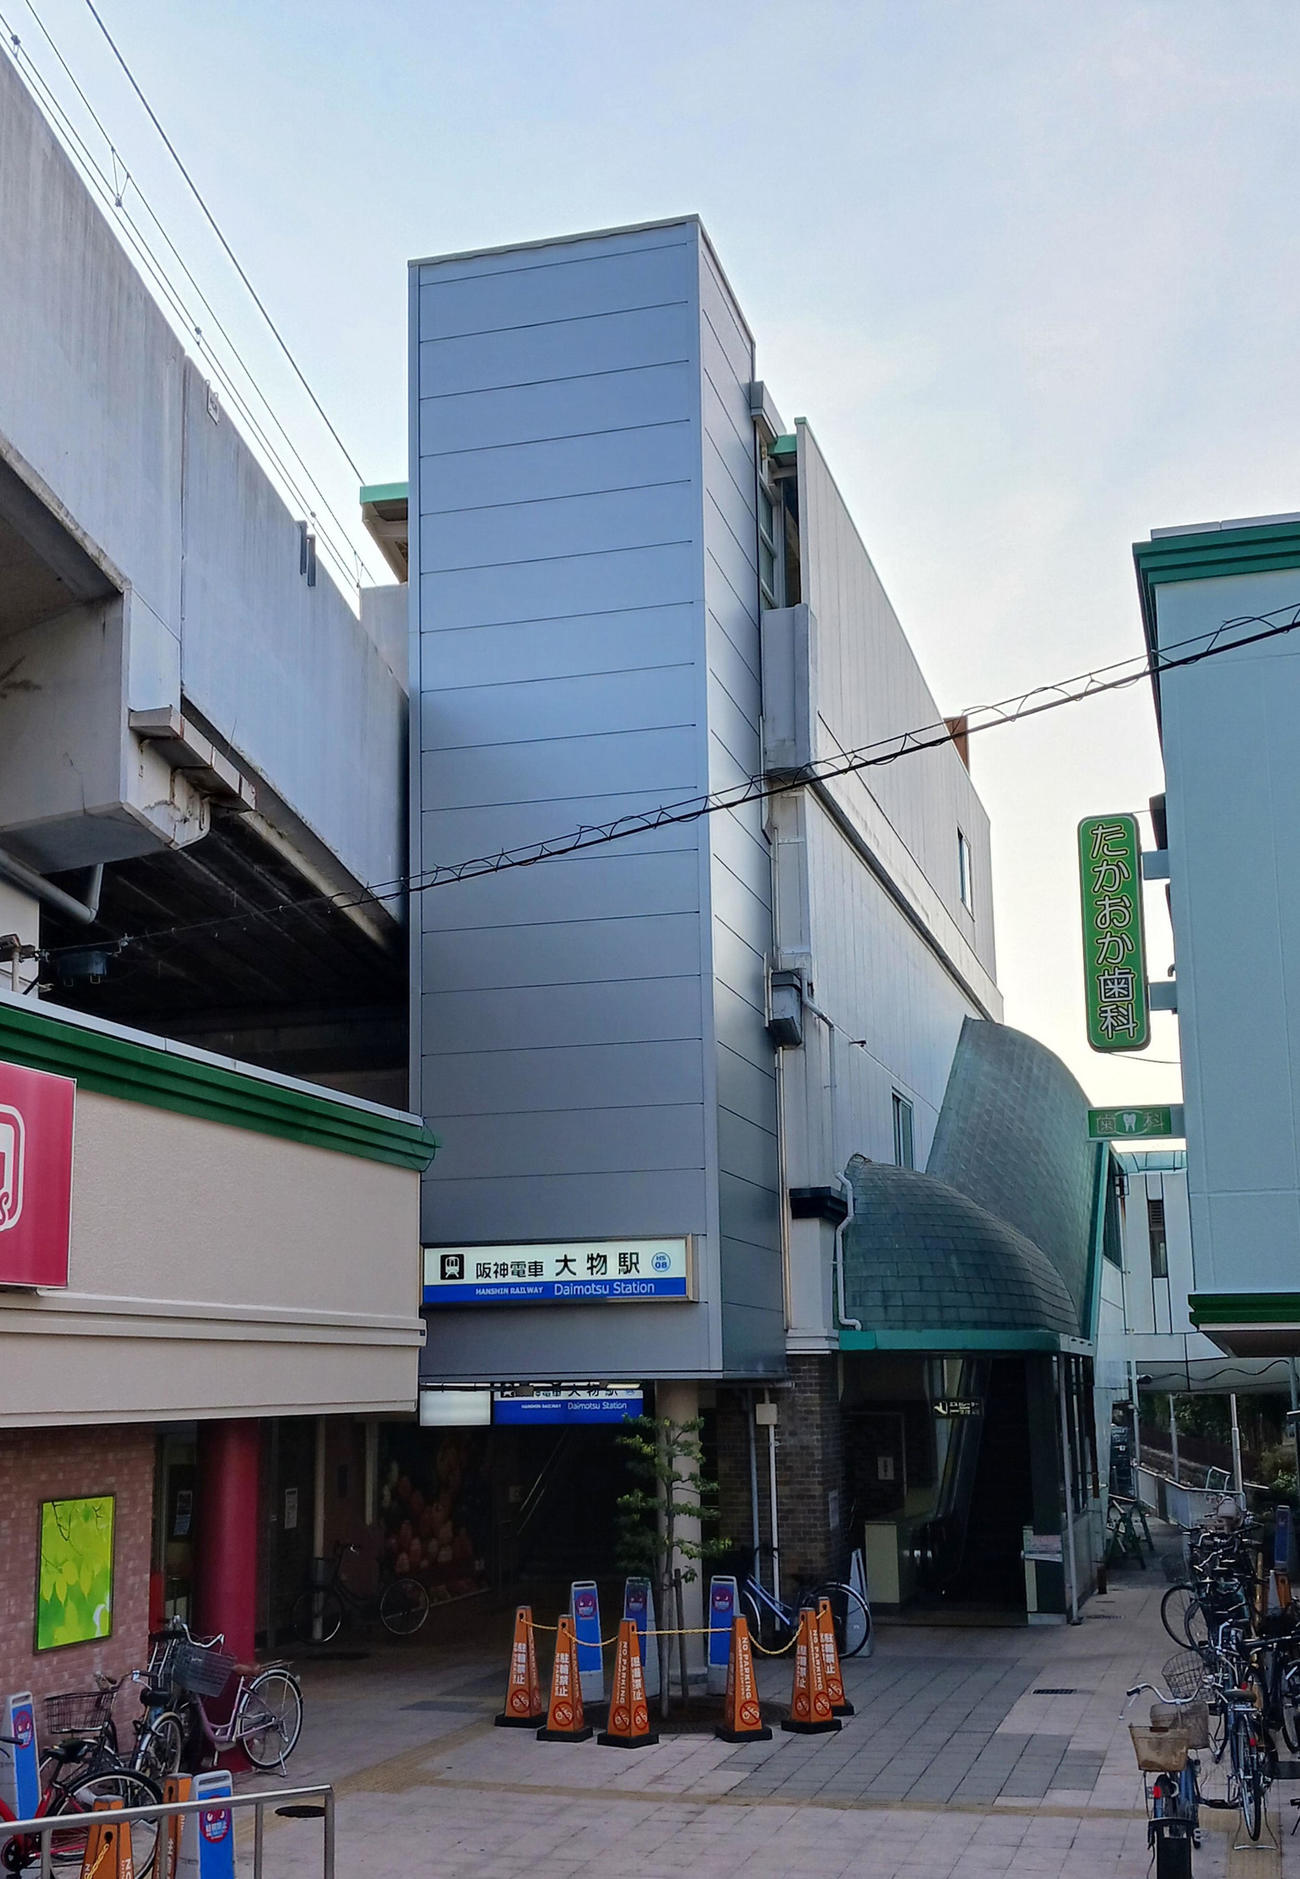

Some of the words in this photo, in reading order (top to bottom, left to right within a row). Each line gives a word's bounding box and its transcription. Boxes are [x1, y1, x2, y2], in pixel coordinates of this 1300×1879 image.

[1090, 823, 1139, 1040] たかおか歯科
[475, 1260, 544, 1279] 阪神電車
[555, 1252, 640, 1277] 大物駅
[655, 1261, 668, 1269] 08
[475, 1287, 509, 1295] HANSHIN
[510, 1286, 544, 1295] RAILWAY
[554, 1283, 609, 1296] Daimotsu
[613, 1281, 655, 1294] Station
[567, 1401, 600, 1410] Daimotsu
[602, 1401, 627, 1410] Station
[743, 1654, 752, 1700] PARKING
